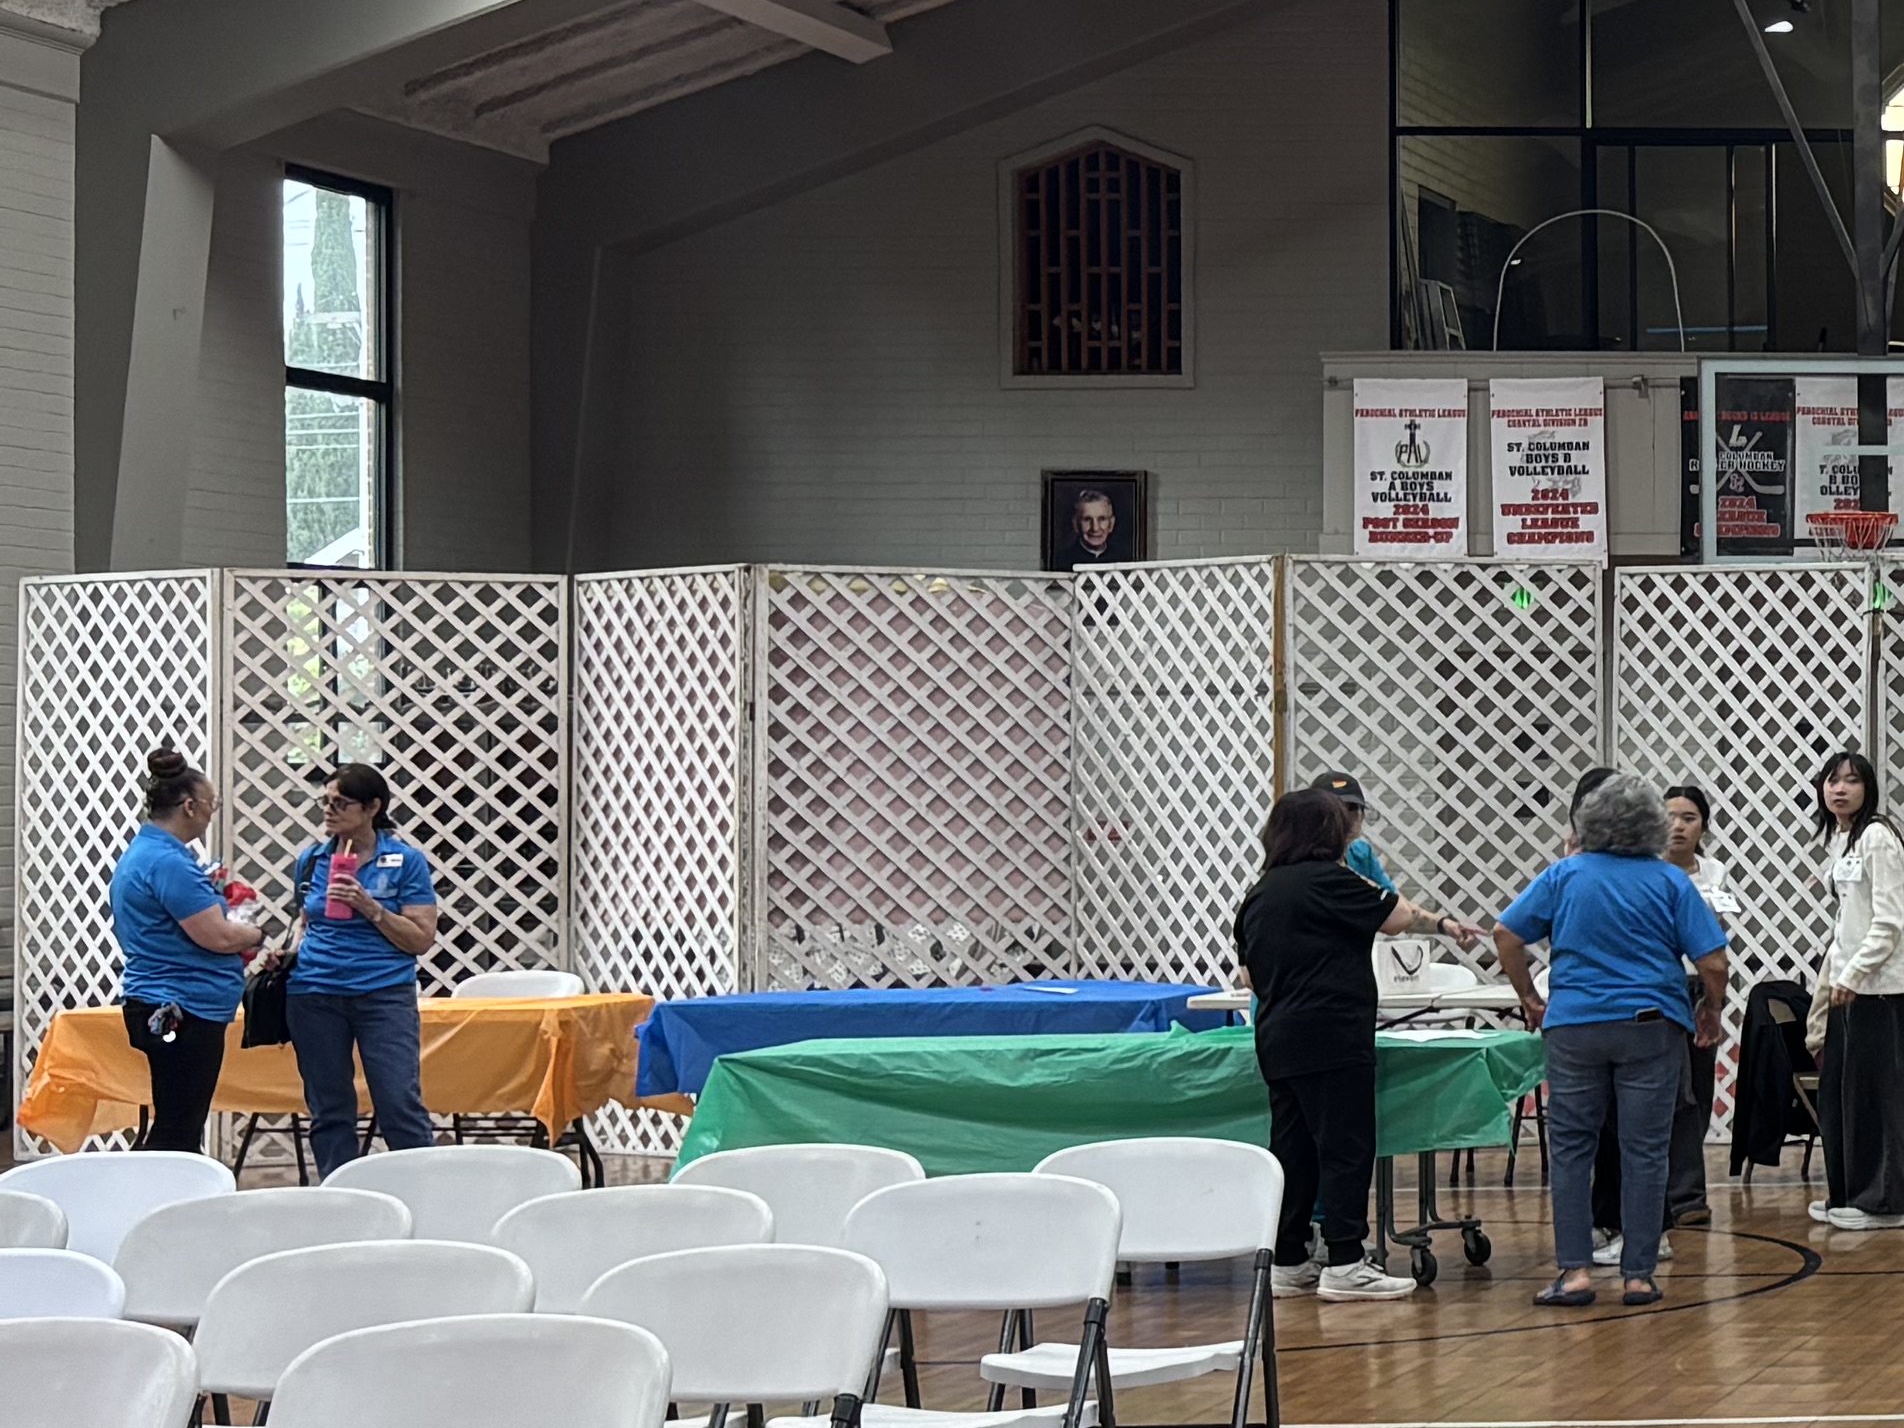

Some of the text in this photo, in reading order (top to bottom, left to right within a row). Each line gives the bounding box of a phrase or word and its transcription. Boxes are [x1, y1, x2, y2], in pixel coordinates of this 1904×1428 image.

[1507, 442, 1524, 452] ST.
[1526, 453, 1559, 464] BOYS
[1370, 471, 1387, 481] ST.
[1508, 465, 1590, 476] VOLLEYBALL
[1388, 481, 1434, 491] A BOYS
[1371, 492, 1452, 503] VOLLEYBALL
[1531, 488, 1569, 501] 2024
